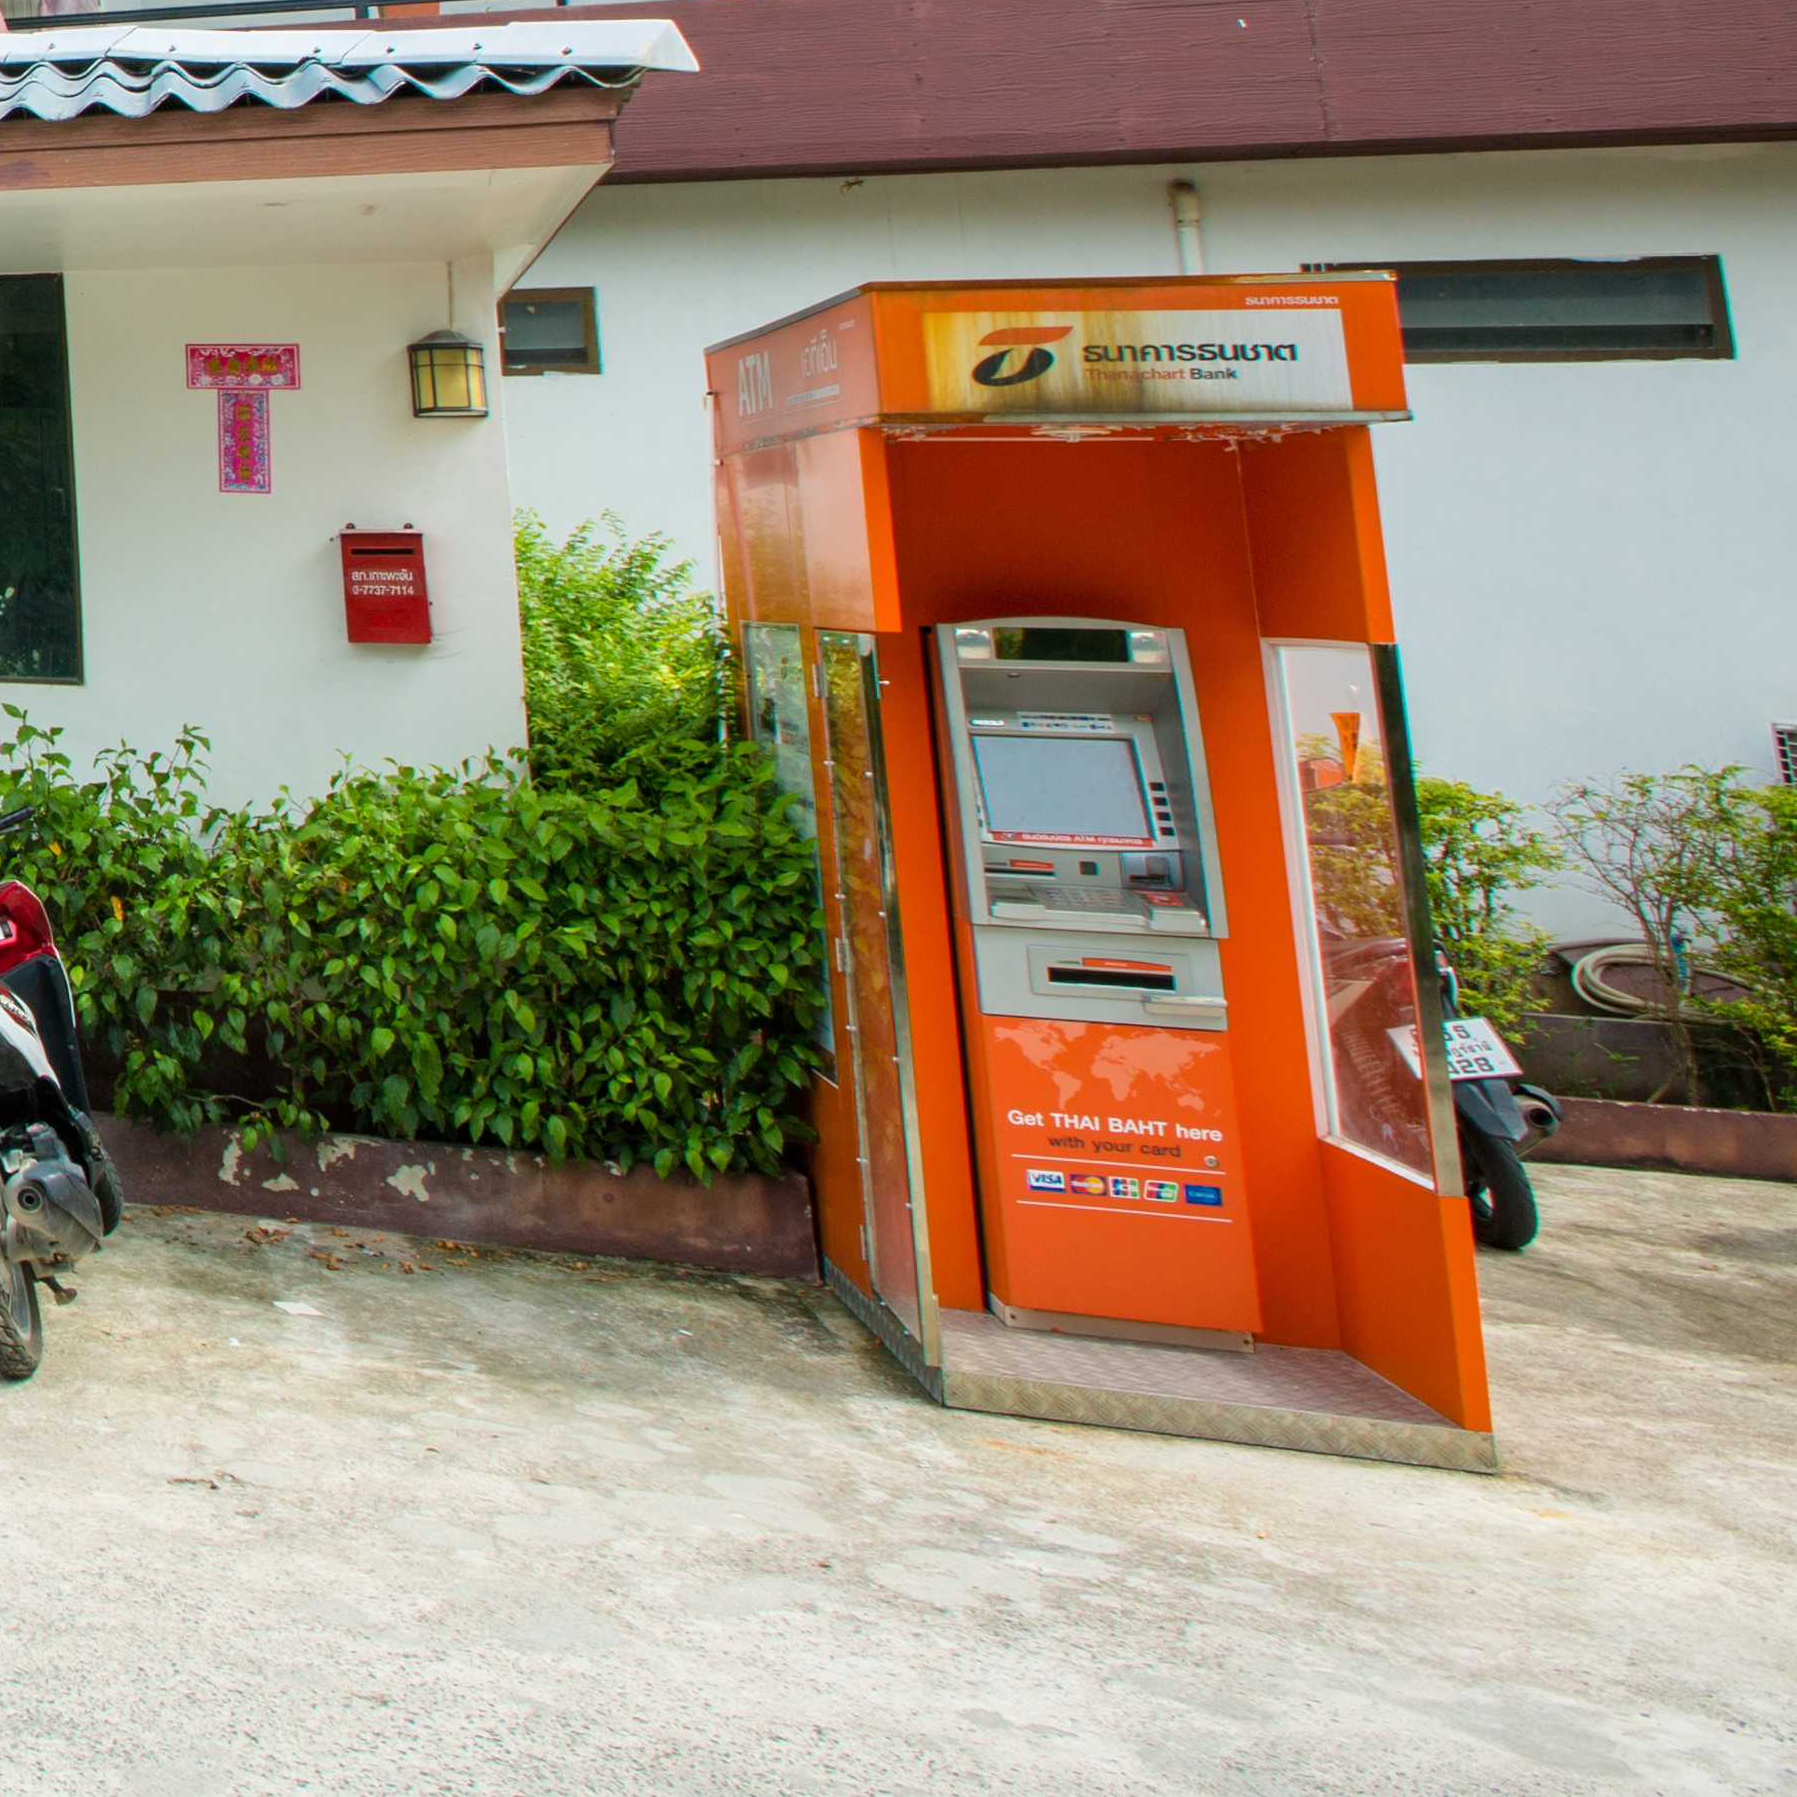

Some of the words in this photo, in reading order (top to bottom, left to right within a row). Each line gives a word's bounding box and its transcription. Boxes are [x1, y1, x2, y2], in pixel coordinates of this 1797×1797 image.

[1083, 343, 1299, 363] ธนาคารธนชาต
[737, 349, 774, 417] ATM
[1085, 367, 1187, 381] Thanachart
[1190, 367, 1238, 381] Bank
[1007, 1109, 1045, 1127] Get
[1049, 1112, 1101, 1132] THAI
[1107, 1116, 1167, 1137] BAHT
[1175, 1122, 1224, 1142] here
[1048, 1135, 1086, 1150] with
[1092, 1140, 1133, 1154] your
[1139, 1142, 1183, 1158] card
[1032, 1174, 1063, 1185] VISA
